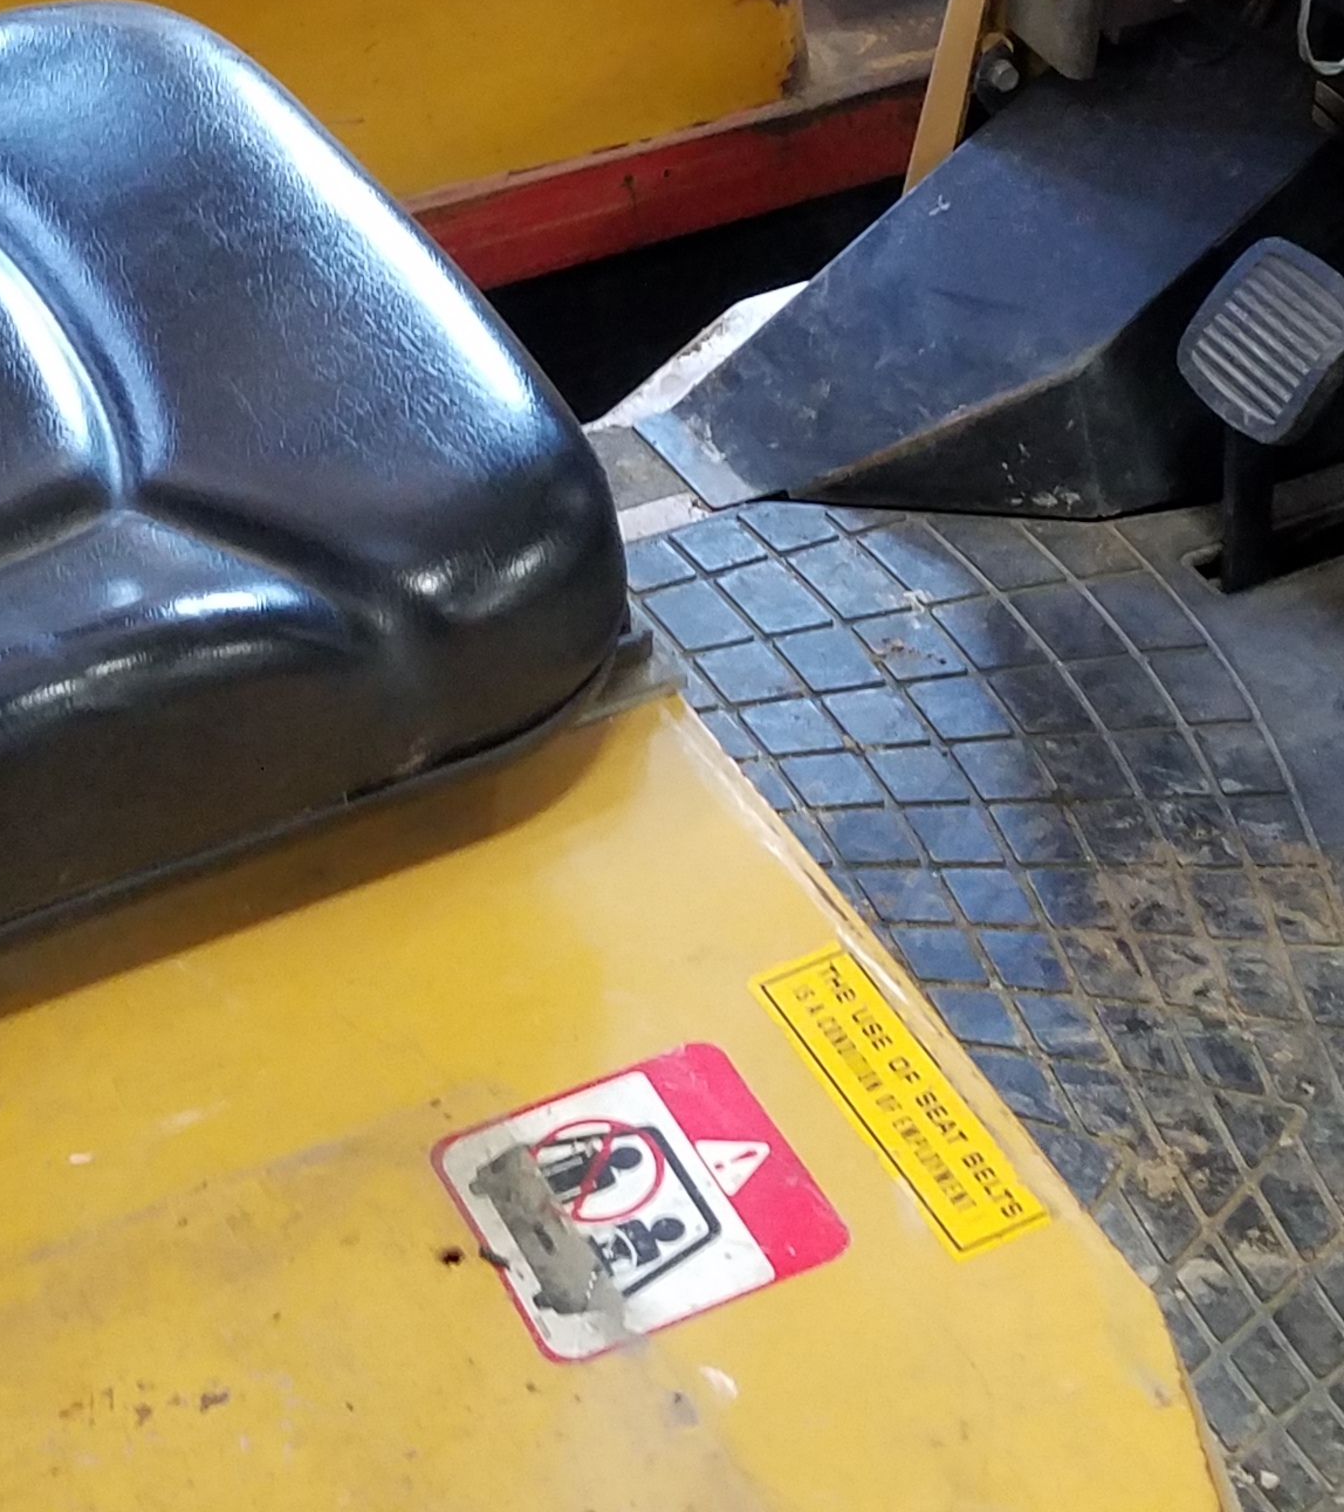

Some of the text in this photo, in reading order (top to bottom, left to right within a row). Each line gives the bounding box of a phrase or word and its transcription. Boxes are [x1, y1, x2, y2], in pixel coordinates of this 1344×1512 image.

[807, 1002, 824, 1017] A
[817, 1016, 883, 1093] CONDTON
[875, 1094, 902, 1113] OF
[820, 960, 1023, 1218] THE USE OF SEAT BELTS
